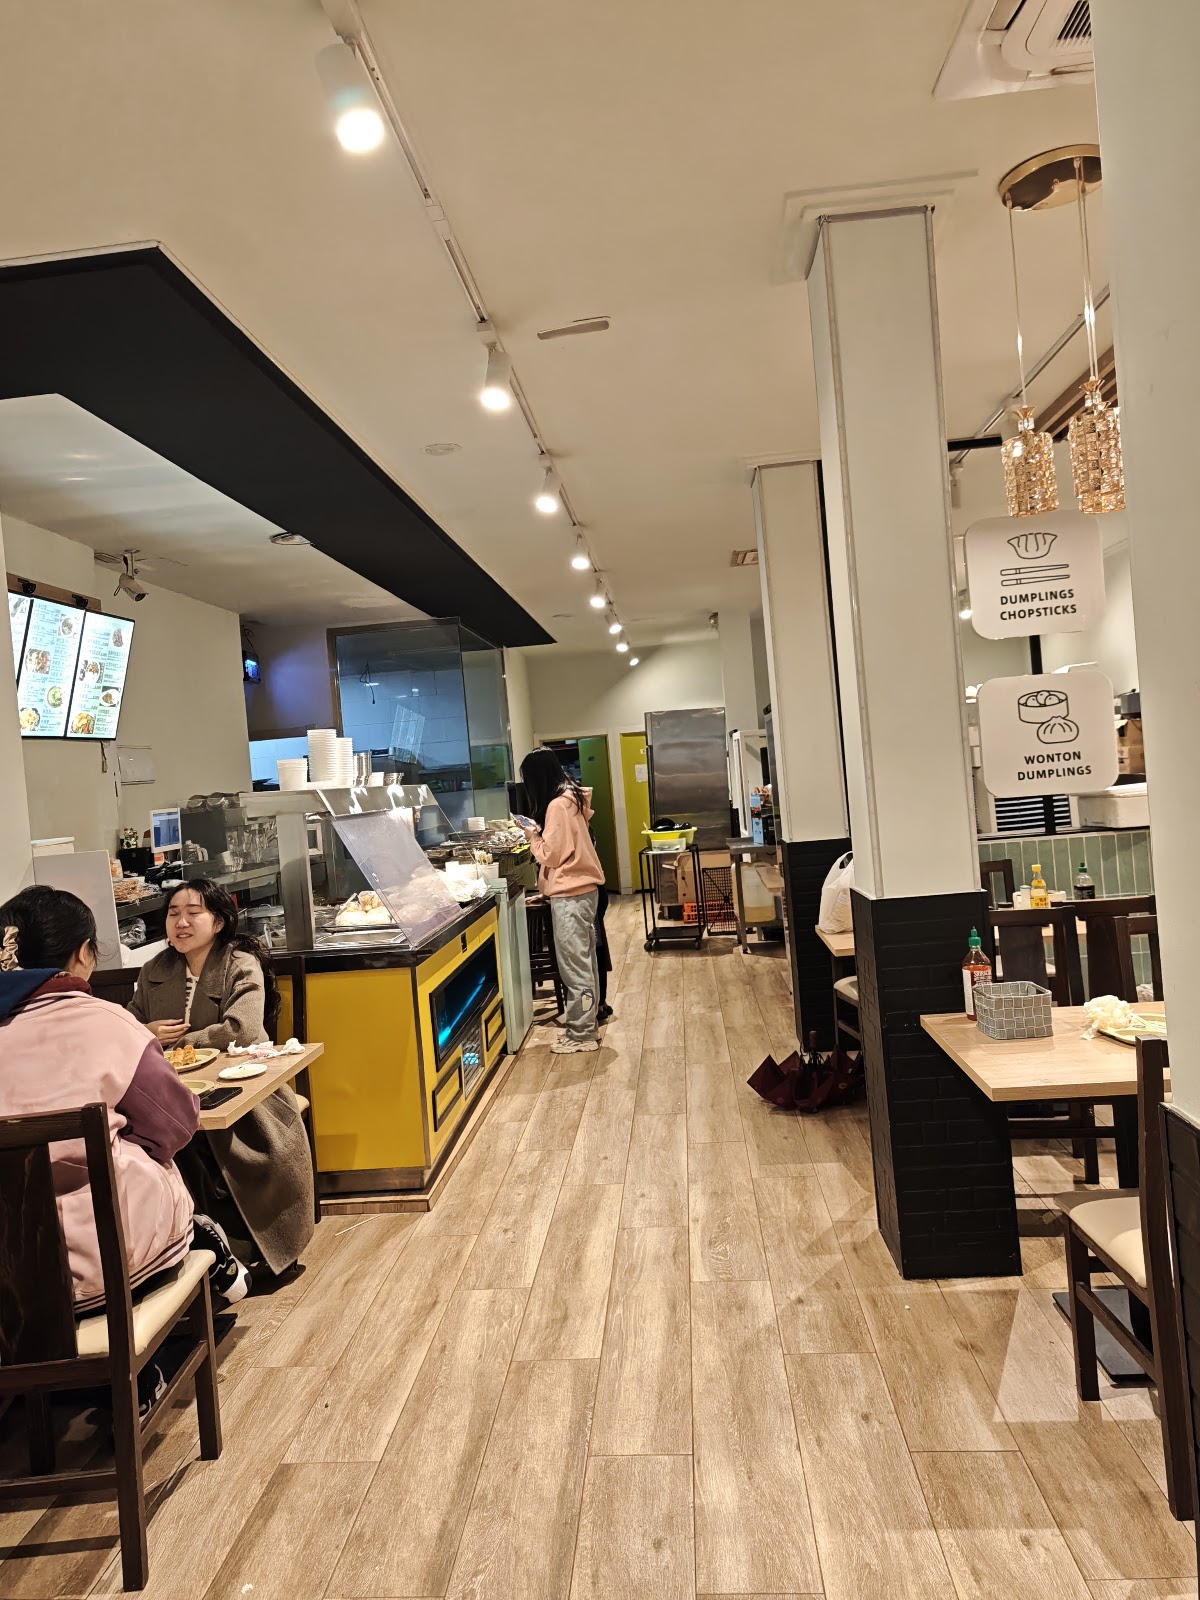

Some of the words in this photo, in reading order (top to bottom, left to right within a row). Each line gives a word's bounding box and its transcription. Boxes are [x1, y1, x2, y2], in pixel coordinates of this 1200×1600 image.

[1000, 588, 1075, 607] DUMPLINGS
[1000, 604, 1077, 621] CHOPSTICKS
[1024, 751, 1082, 765] WONTON
[1017, 765, 1092, 781] DUMPLINGS
